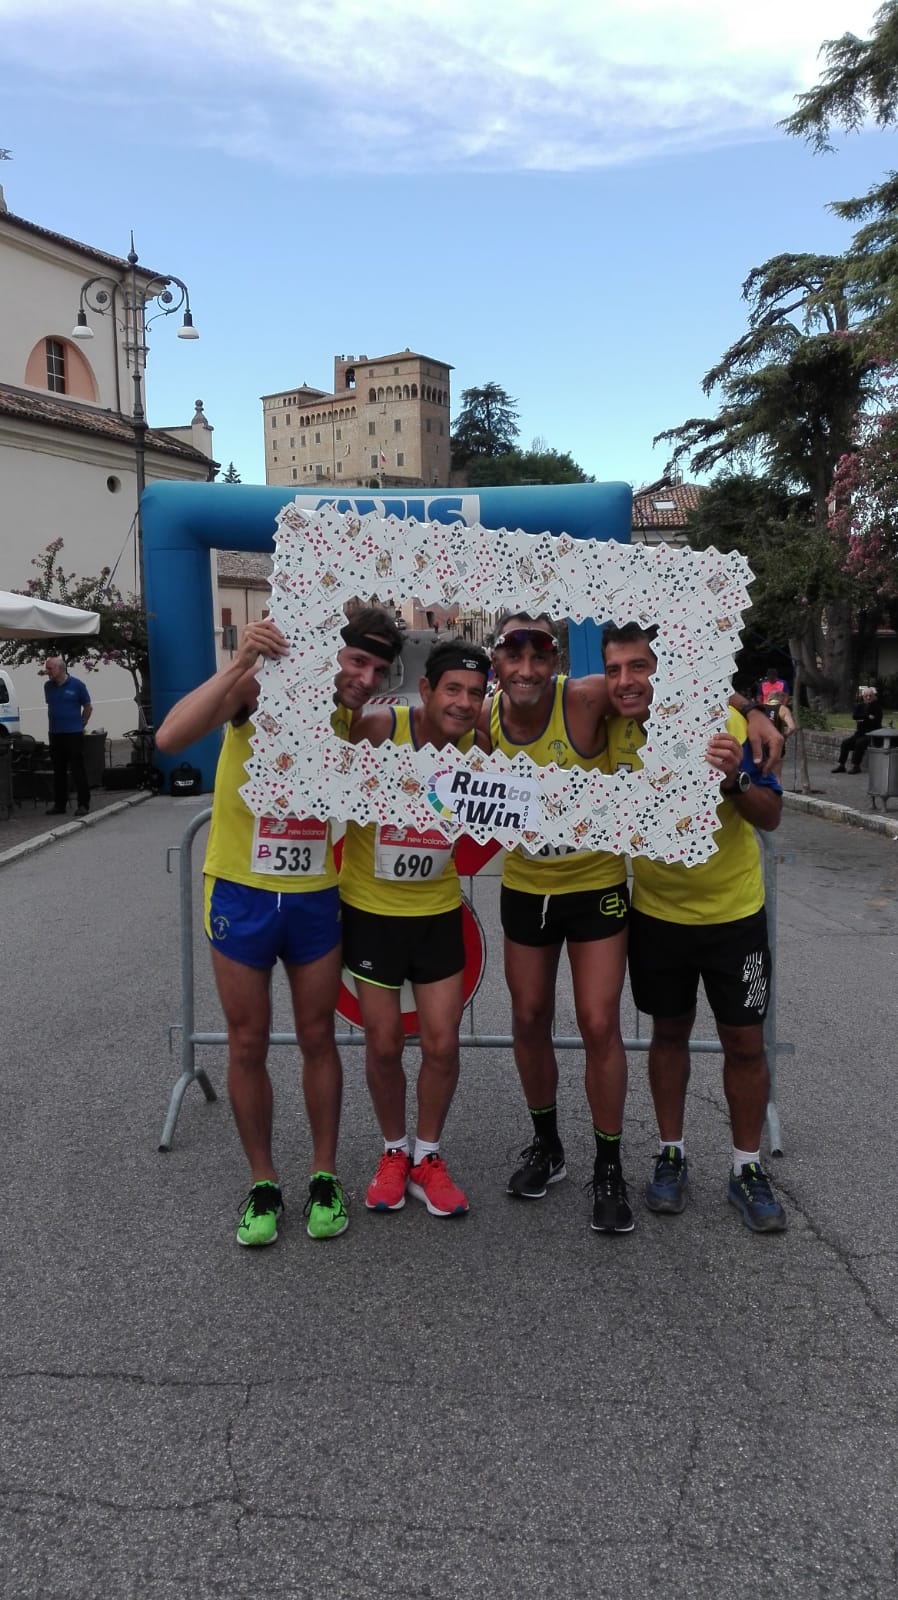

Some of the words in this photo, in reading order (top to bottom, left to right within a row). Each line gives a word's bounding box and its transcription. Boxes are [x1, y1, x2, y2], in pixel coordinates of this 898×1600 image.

[451, 771, 507, 800] Run
[507, 786, 531, 803] to
[466, 801, 521, 829] Win
[257, 844, 272, 859] B
[273, 847, 311, 872] 533
[393, 854, 433, 877] 690
